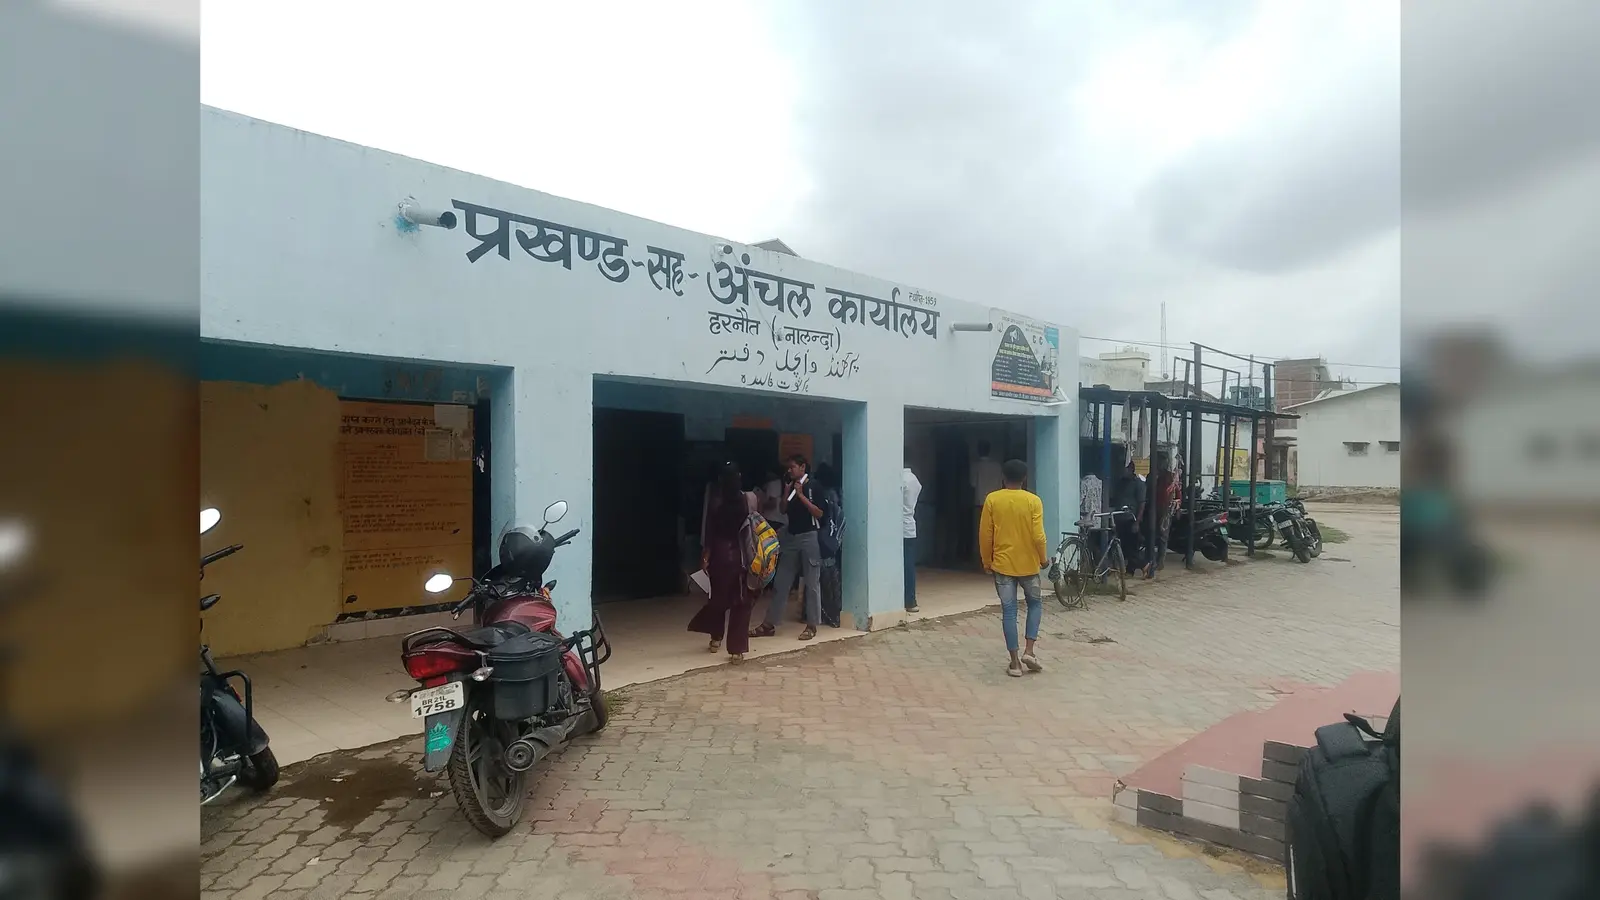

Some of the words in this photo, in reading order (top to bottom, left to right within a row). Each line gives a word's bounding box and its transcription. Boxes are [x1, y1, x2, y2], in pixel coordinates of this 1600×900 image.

[707, 307, 761, 336] हरनौत
[825, 286, 940, 340] कार्यालय
[415, 699, 455, 716] 1758
[422, 698, 433, 706] BR
[434, 695, 447, 703] 21L
